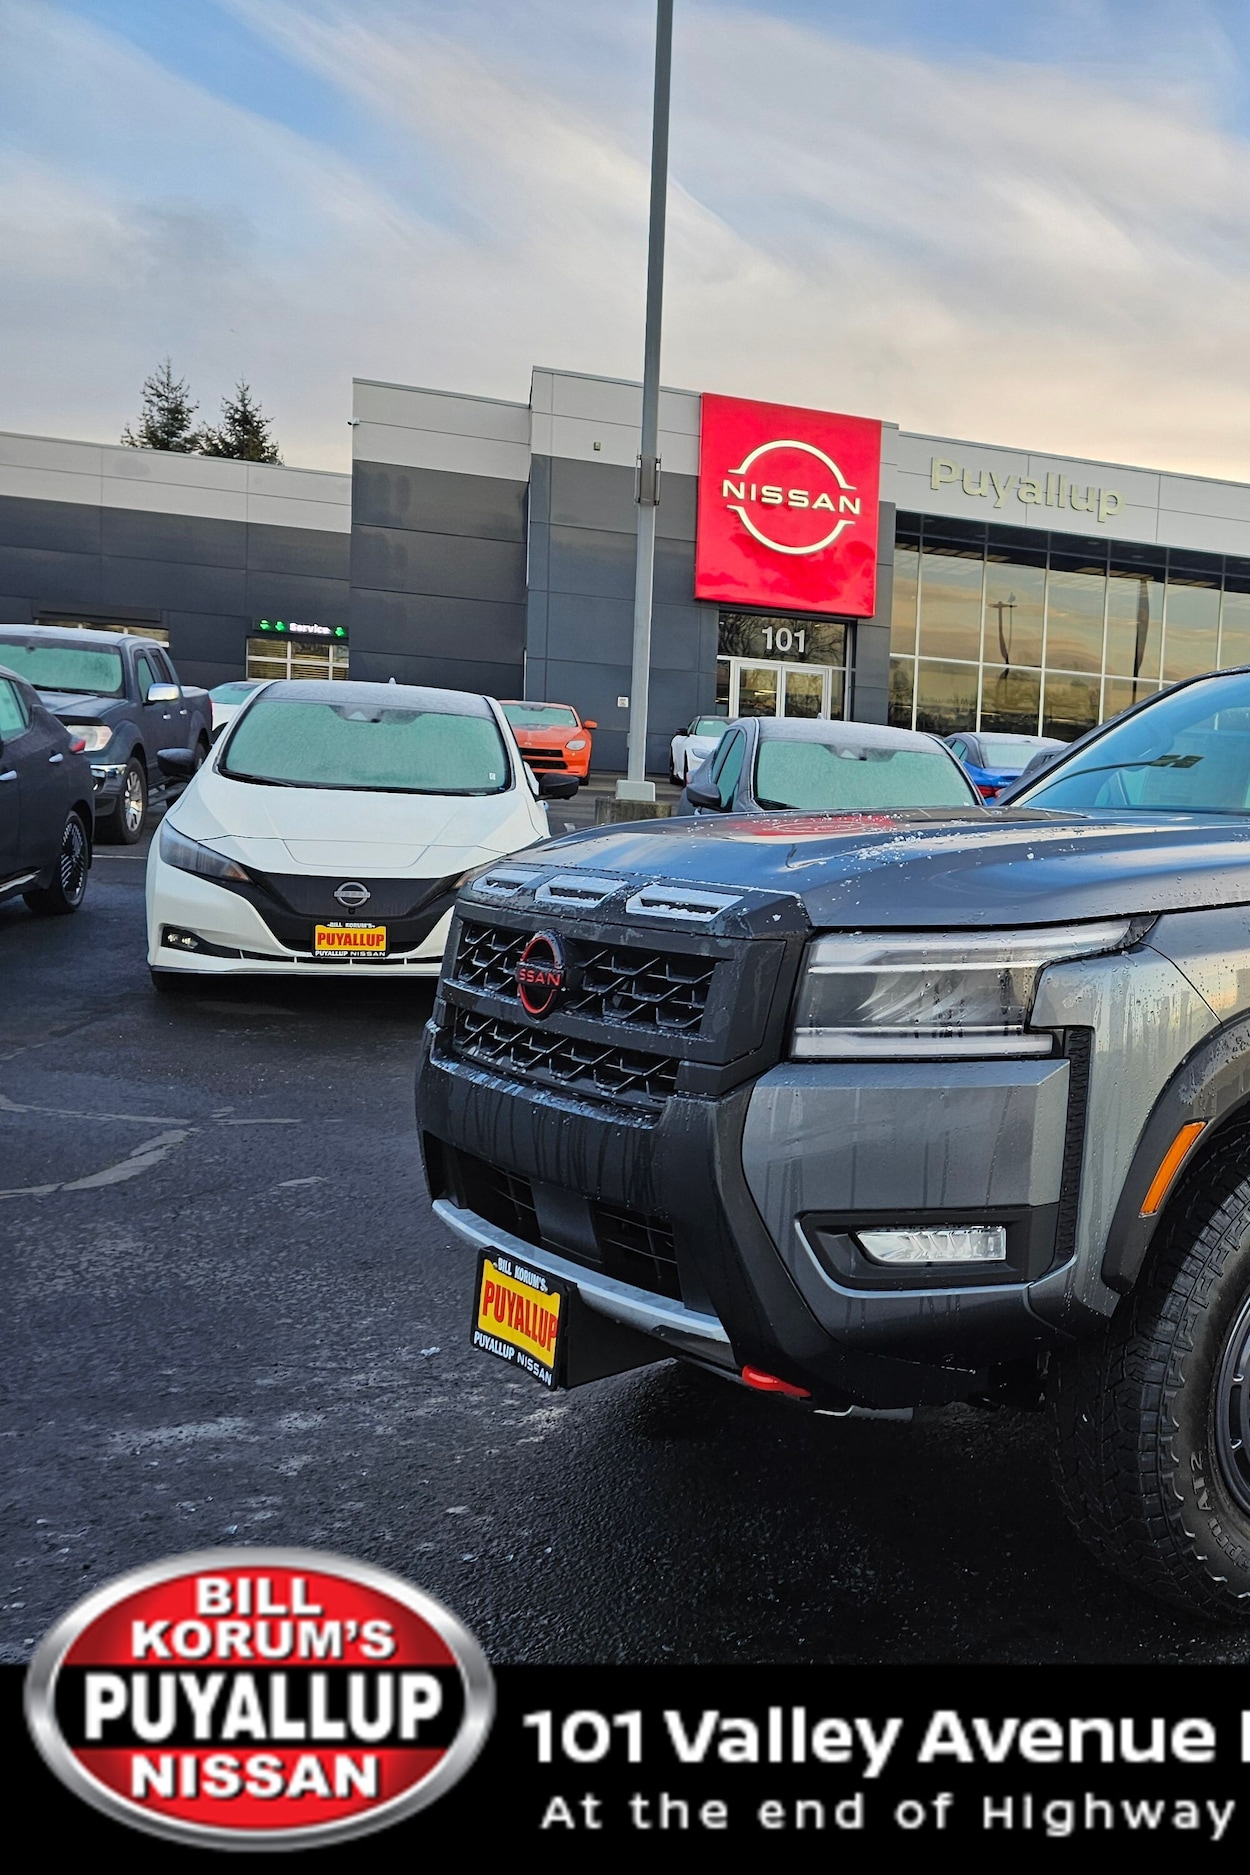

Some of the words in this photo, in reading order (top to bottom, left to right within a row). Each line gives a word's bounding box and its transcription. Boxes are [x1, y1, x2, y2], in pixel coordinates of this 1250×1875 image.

[722, 479, 861, 515] NISSAN
[931, 456, 1126, 523] Puyallup
[289, 622, 331, 635] Service
[761, 626, 806, 653] 101
[316, 932, 385, 947] PUYALLUP
[518, 967, 562, 987] SSAN
[497, 1257, 512, 1275] BILL
[514, 1264, 547, 1291] KORUM'S
[482, 1280, 558, 1352] PUYALLUP
[473, 1330, 515, 1360] PUYALLUP
[516, 1351, 553, 1386] NISSAN
